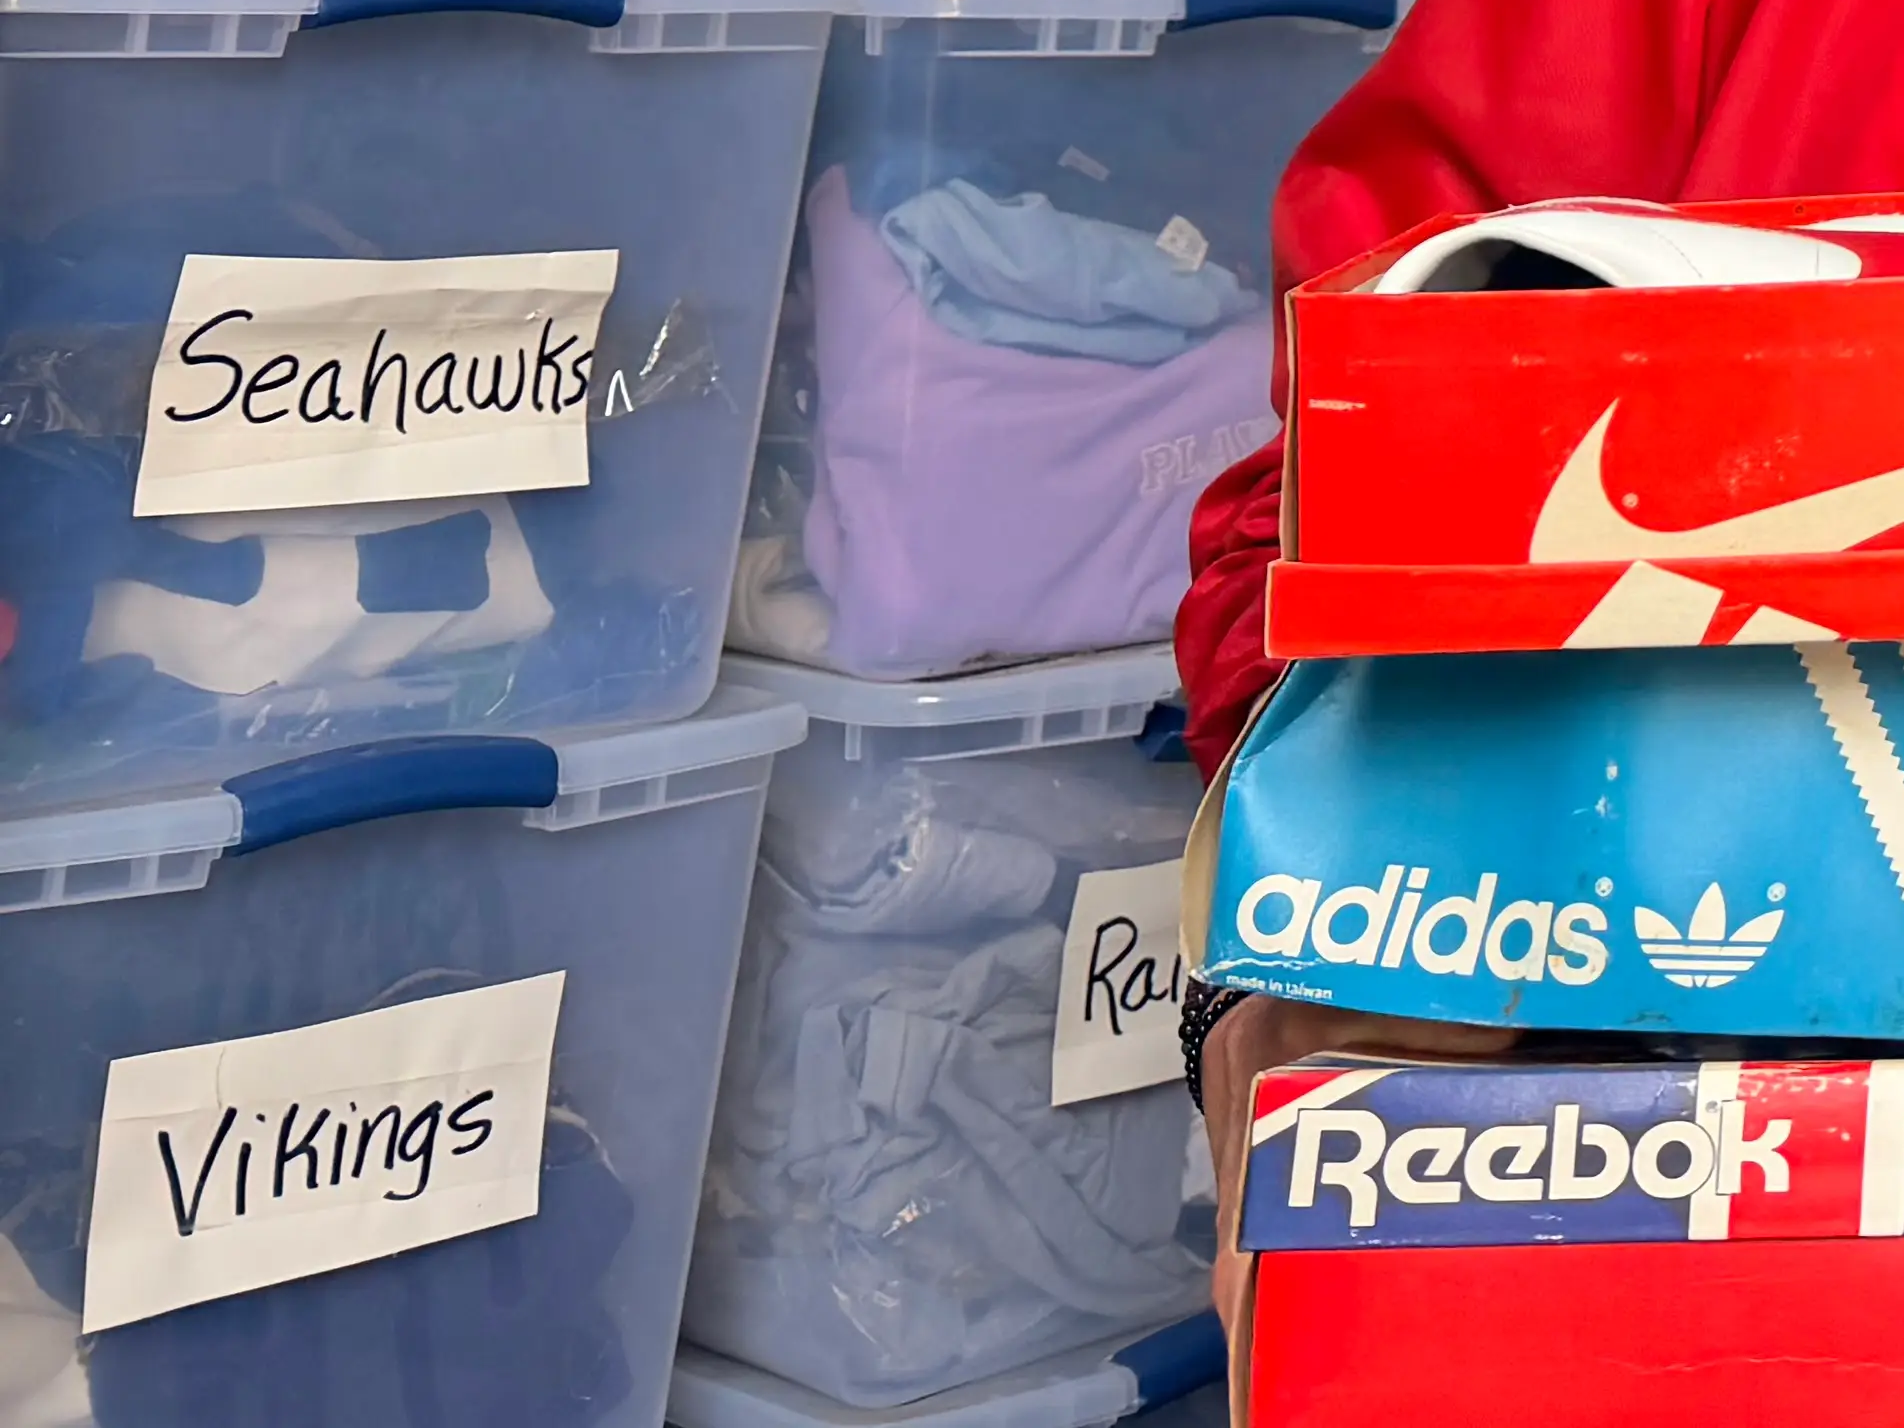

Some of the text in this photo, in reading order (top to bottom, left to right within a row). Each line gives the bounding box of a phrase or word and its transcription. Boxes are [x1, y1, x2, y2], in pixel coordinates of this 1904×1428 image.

[164, 308, 593, 435] Seahawks
[1226, 975, 1333, 1000] made in taiwan
[1236, 864, 1609, 986] adidas
[157, 1087, 494, 1237] Vikings
[1287, 1100, 1793, 1228] Reebok
